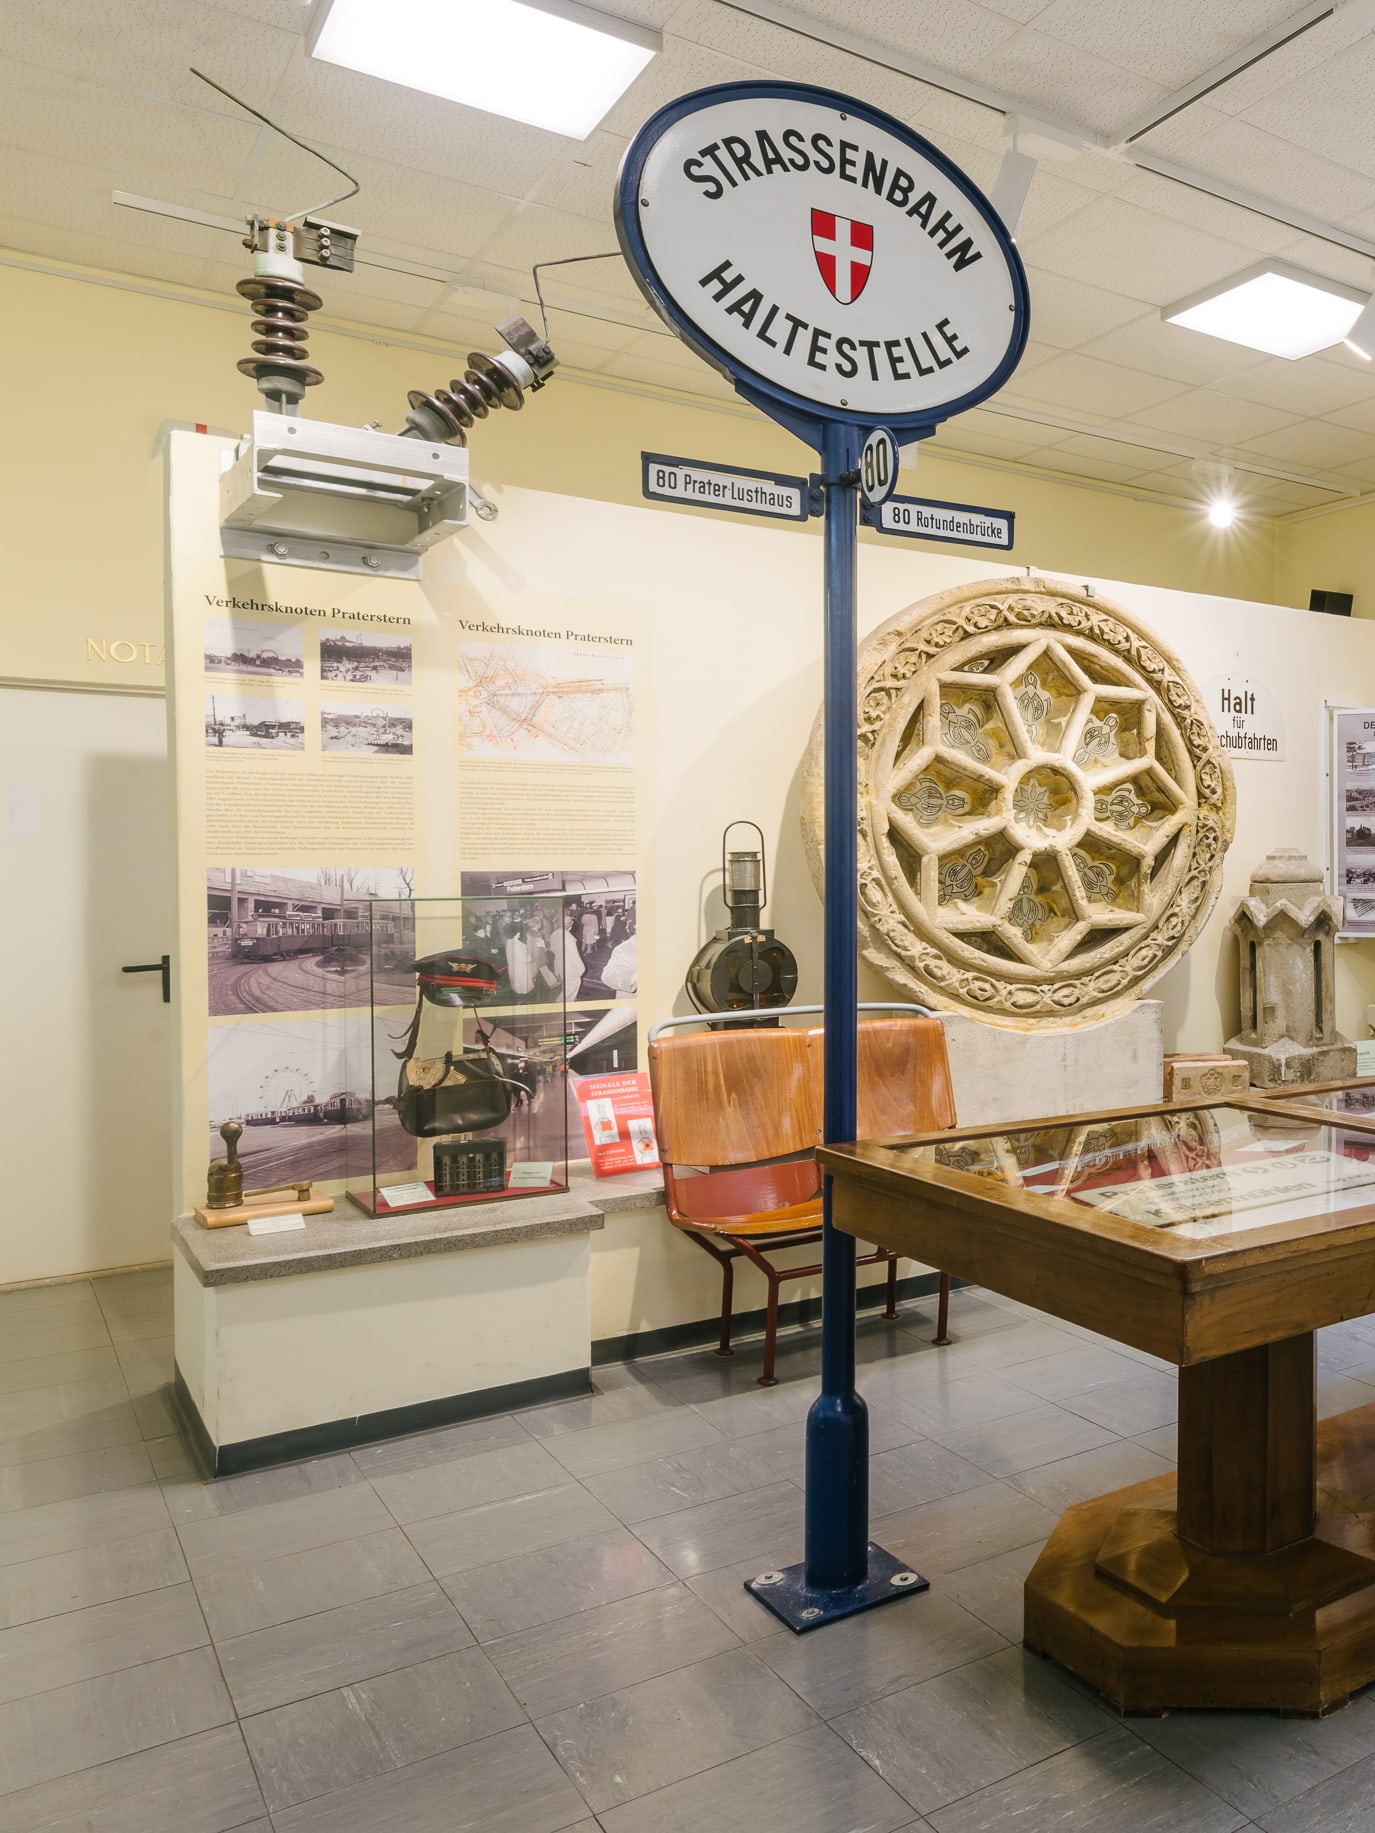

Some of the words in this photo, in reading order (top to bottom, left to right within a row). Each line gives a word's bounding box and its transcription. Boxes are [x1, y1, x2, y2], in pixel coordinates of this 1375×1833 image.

[683, 128, 982, 272] STRASSENBAHN
[698, 259, 970, 382] HALTESTELLE
[864, 437, 888, 492] 80
[656, 468, 677, 491] 80
[892, 507, 910, 526] 80
[916, 510, 1003, 539] Rotundenbrücke
[204, 594, 327, 618] Verkehrsknoten
[331, 607, 412, 625] Praterstern
[458, 619, 562, 641] Verkehrsknoten
[565, 630, 634, 646] Praterstern
[1222, 688, 1255, 715] Halt
[1233, 716, 1245, 729] für
[1217, 730, 1278, 752] chubfahrten
